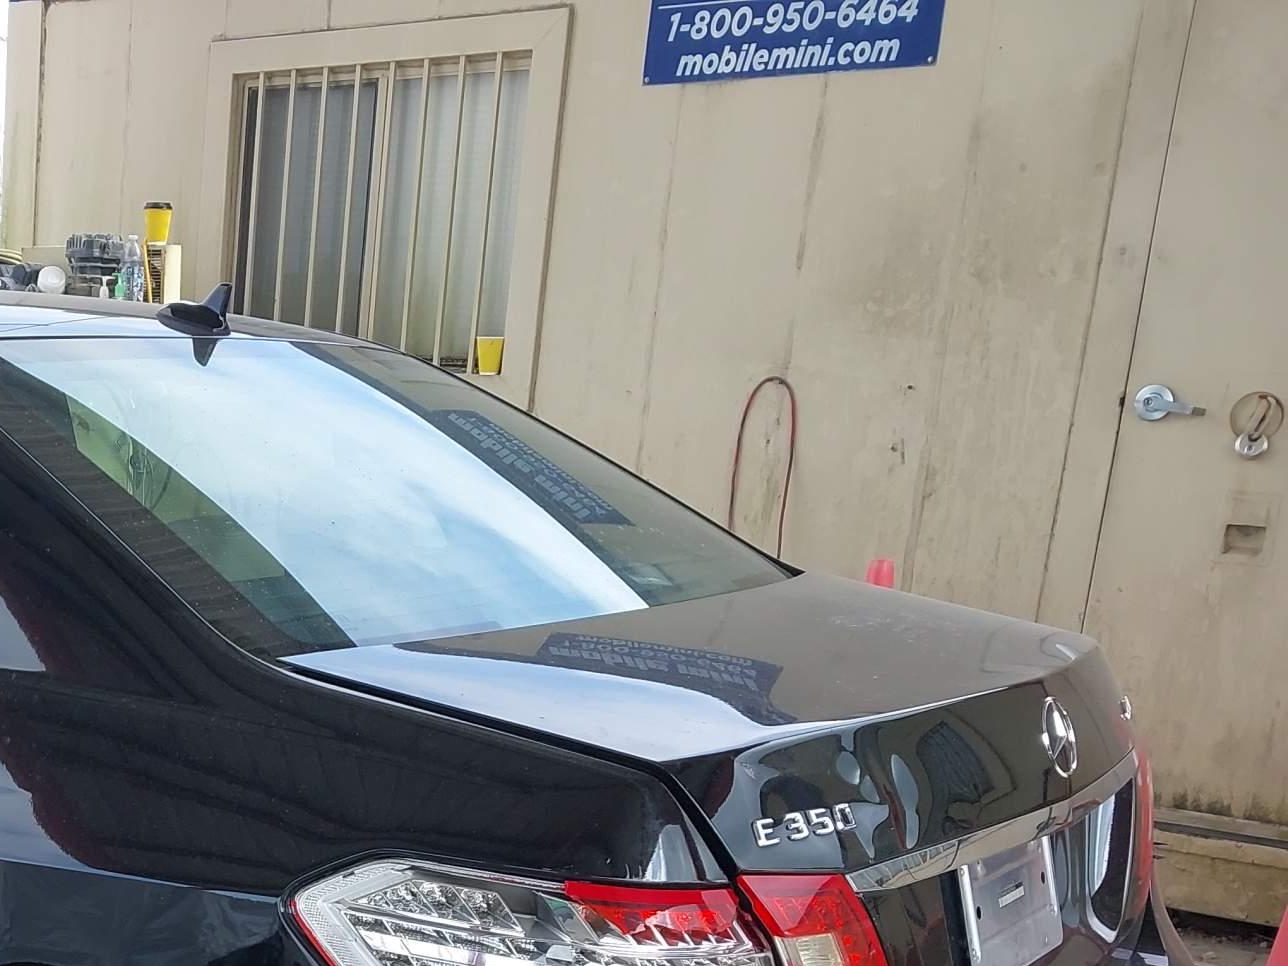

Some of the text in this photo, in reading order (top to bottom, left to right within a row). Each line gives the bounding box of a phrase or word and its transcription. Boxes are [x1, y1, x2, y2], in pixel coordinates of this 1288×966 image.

[667, 0, 919, 42] 1-800-950-6464
[675, 37, 901, 76] mobilemini.com
[751, 803, 857, 847] E 350
